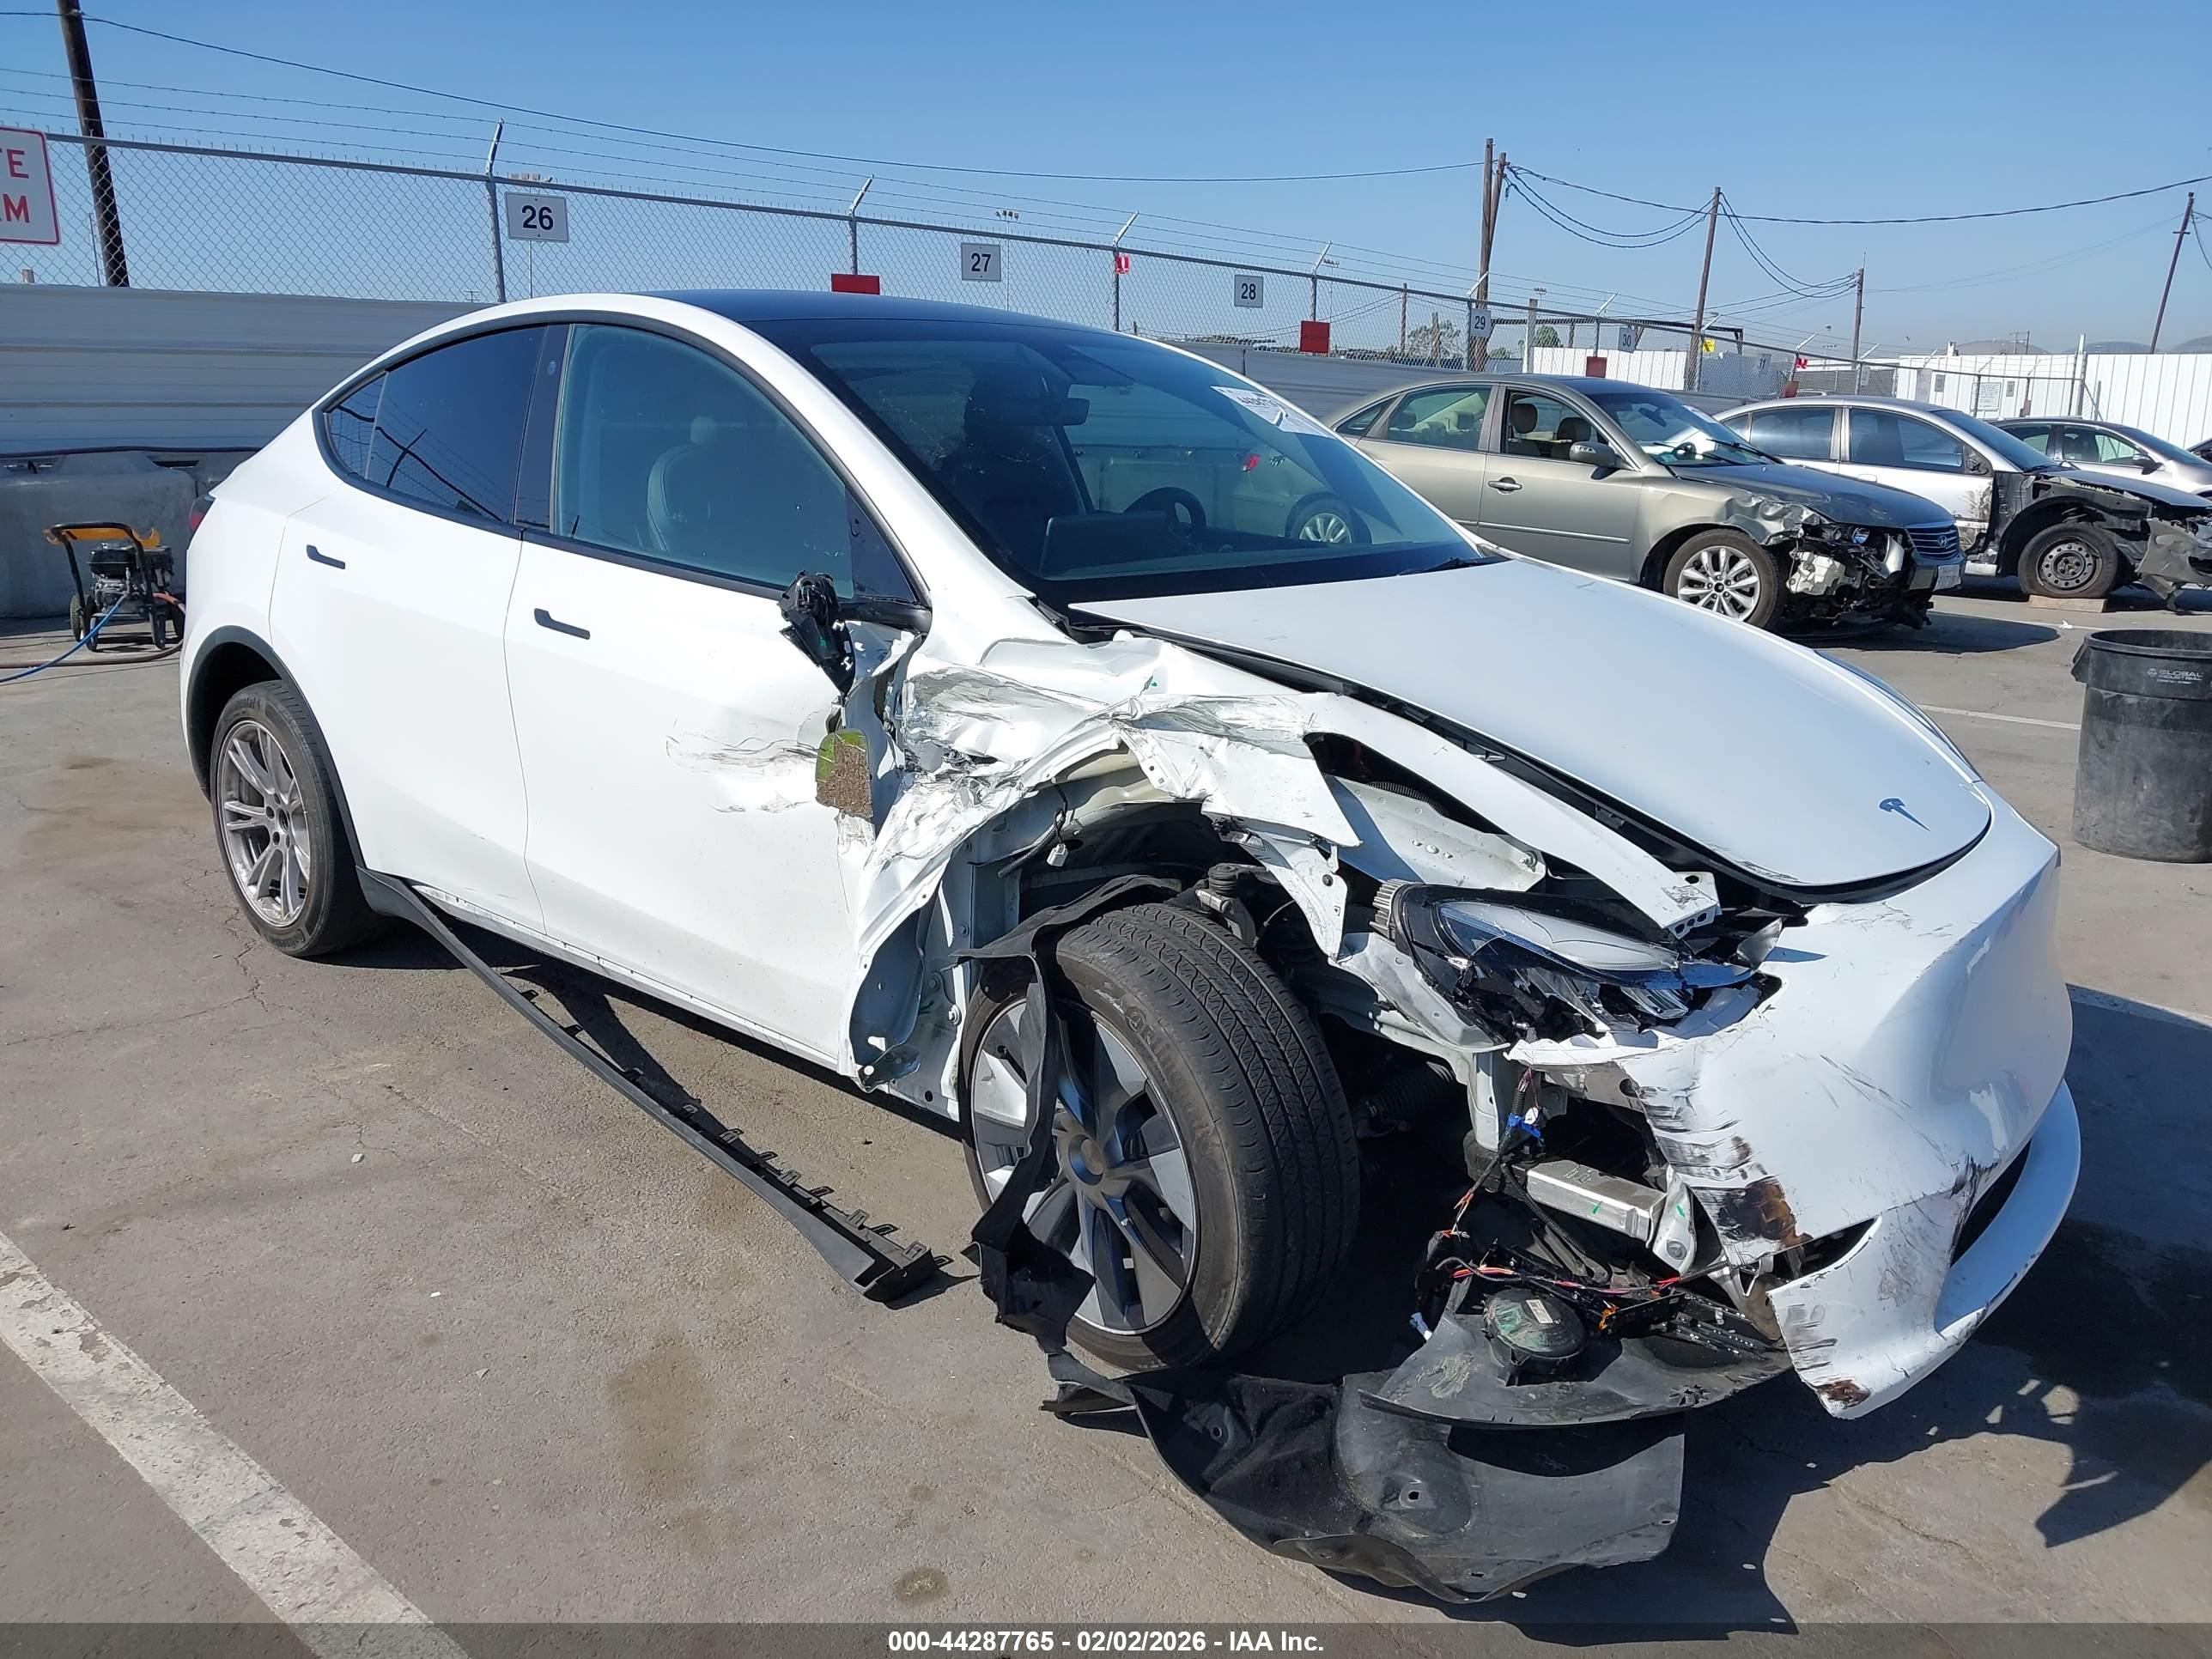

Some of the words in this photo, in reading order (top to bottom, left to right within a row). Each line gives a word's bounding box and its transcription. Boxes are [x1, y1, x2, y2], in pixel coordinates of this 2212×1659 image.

[0, 148, 30, 179] E
[0, 193, 30, 223] M
[521, 204, 554, 231] 26
[970, 252, 992, 272] 27
[1241, 283, 1256, 301] 28
[1474, 315, 1486, 331] 29
[1622, 333, 1632, 348] 30
[2158, 669, 2203, 678] GLOBAL
